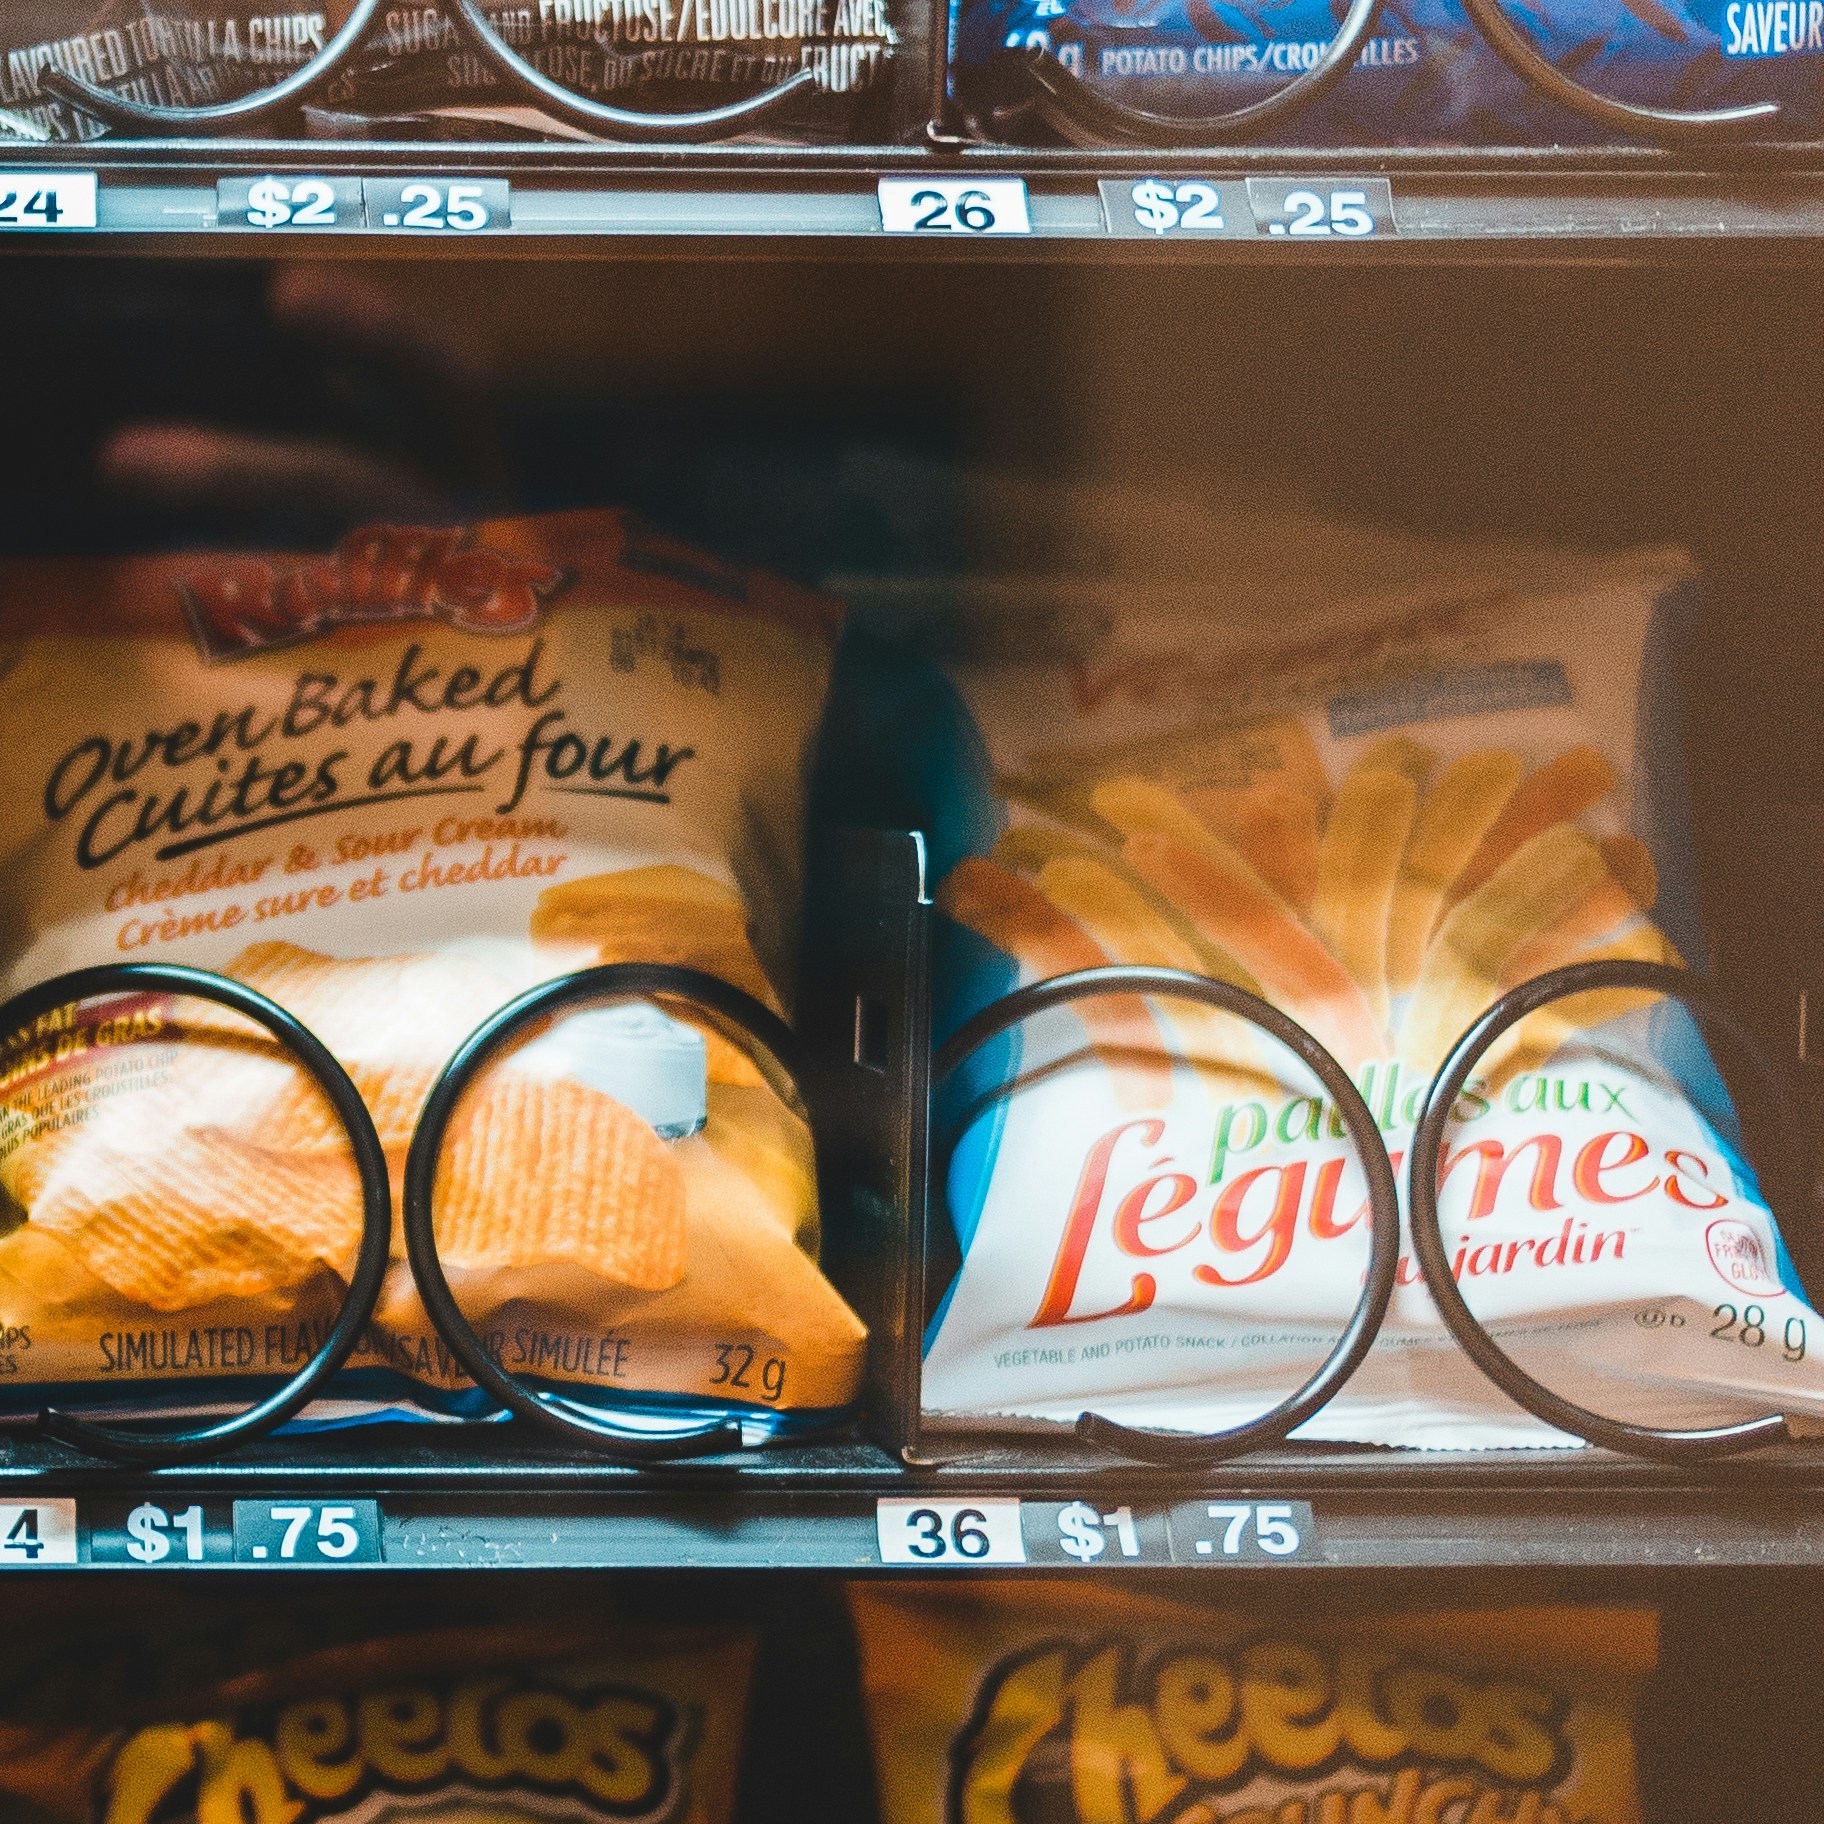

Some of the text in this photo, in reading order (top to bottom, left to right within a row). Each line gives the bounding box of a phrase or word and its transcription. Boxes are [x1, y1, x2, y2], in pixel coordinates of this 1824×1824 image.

[1101, 43, 1188, 78] POTATO
[248, 176, 490, 230] $2 .25
[909, 189, 997, 231] 26
[1132, 179, 1376, 238] $2 .25
[44, 700, 280, 822] Oven
[282, 638, 562, 739] Baked
[76, 709, 696, 868] Cuites au four
[105, 851, 282, 916] Cheddar
[329, 820, 425, 869] Sour
[431, 808, 571, 849] Cream
[116, 844, 571, 954] Crème sure et cheddar
[1505, 1072, 1637, 1121] aux
[1455, 1216, 1628, 1282] jardin
[98, 1329, 254, 1375] SIMULATED
[993, 1346, 1077, 1370] VEGETABLE
[1079, 1343, 1111, 1362] AND
[1113, 1335, 1171, 1356] POTATO
[1709, 1302, 1808, 1364] 28 g
[708, 1342, 788, 1403] 32 g
[125, 1501, 360, 1564] $1 .75
[905, 1511, 992, 1561] 36
[1058, 1500, 1301, 1562] $1 .75
